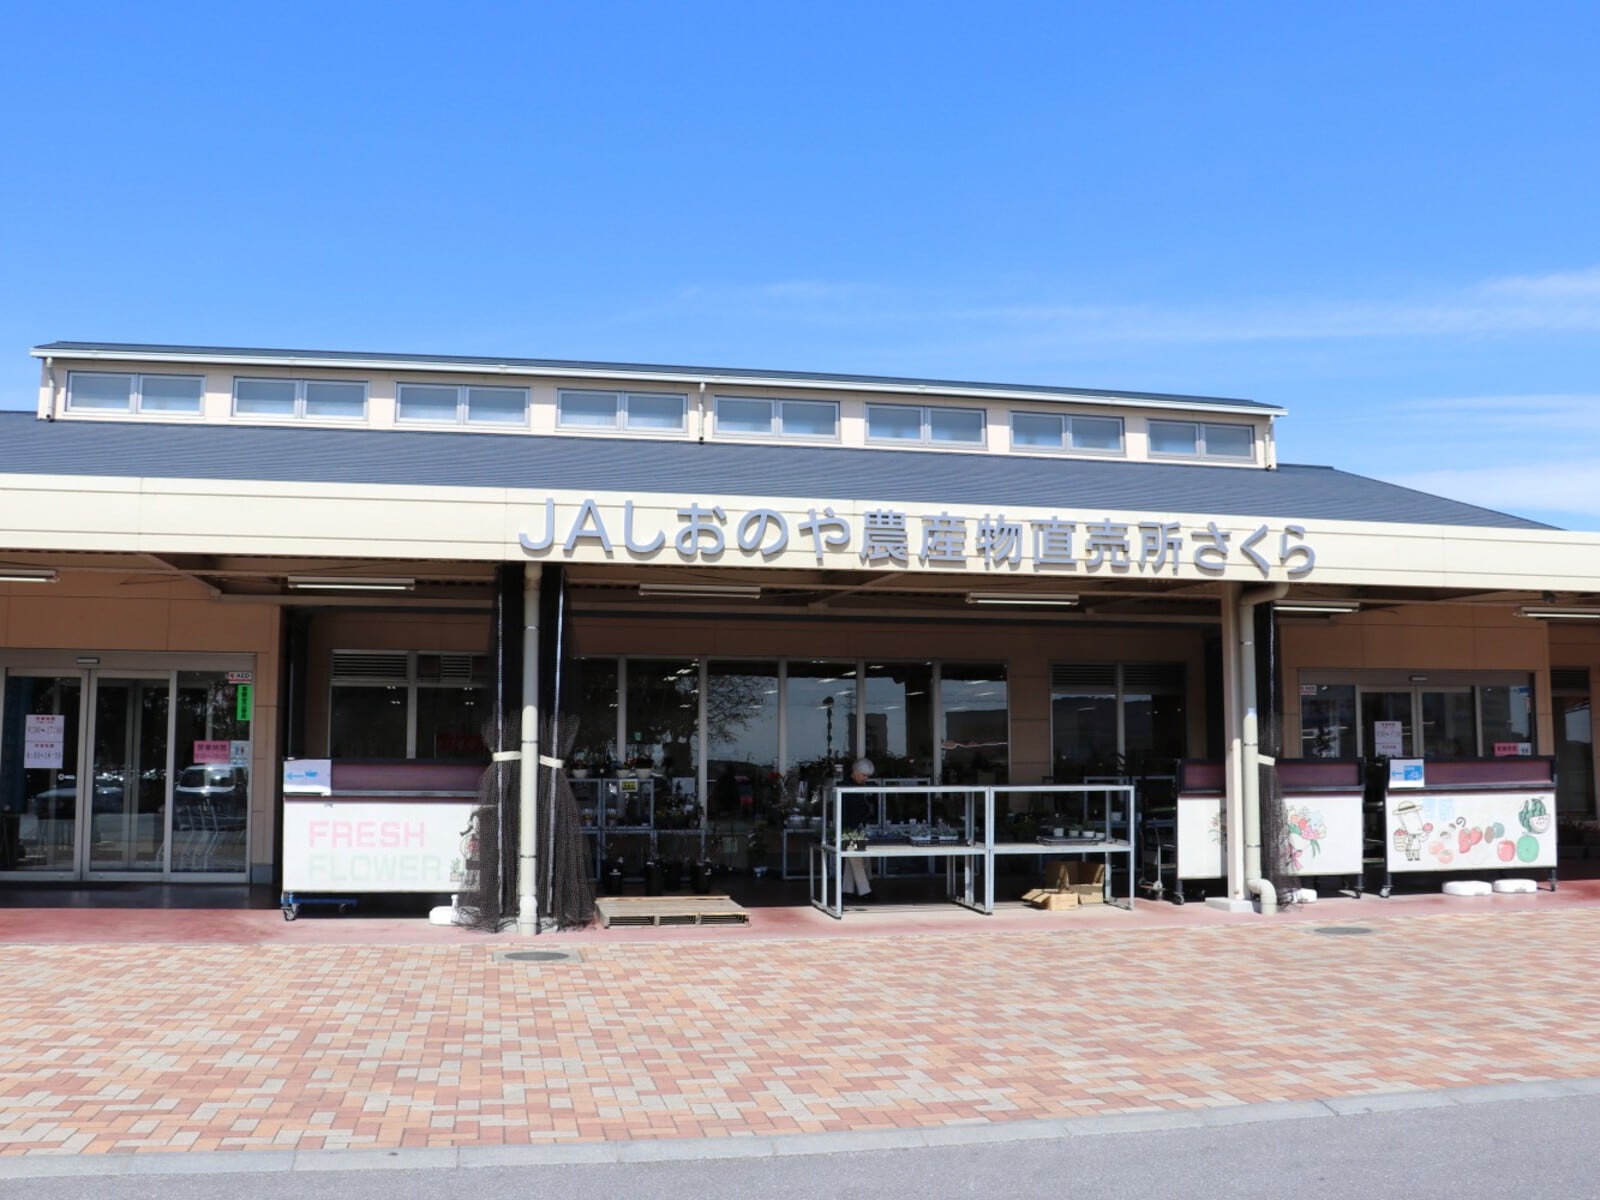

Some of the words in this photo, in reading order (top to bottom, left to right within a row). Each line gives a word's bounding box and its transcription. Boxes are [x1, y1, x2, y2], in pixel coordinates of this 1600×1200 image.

[518, 497, 1316, 575] JAしおのや農産物直売所さくら
[308, 820, 425, 848] FRESH
[308, 853, 442, 881] FLOWER
